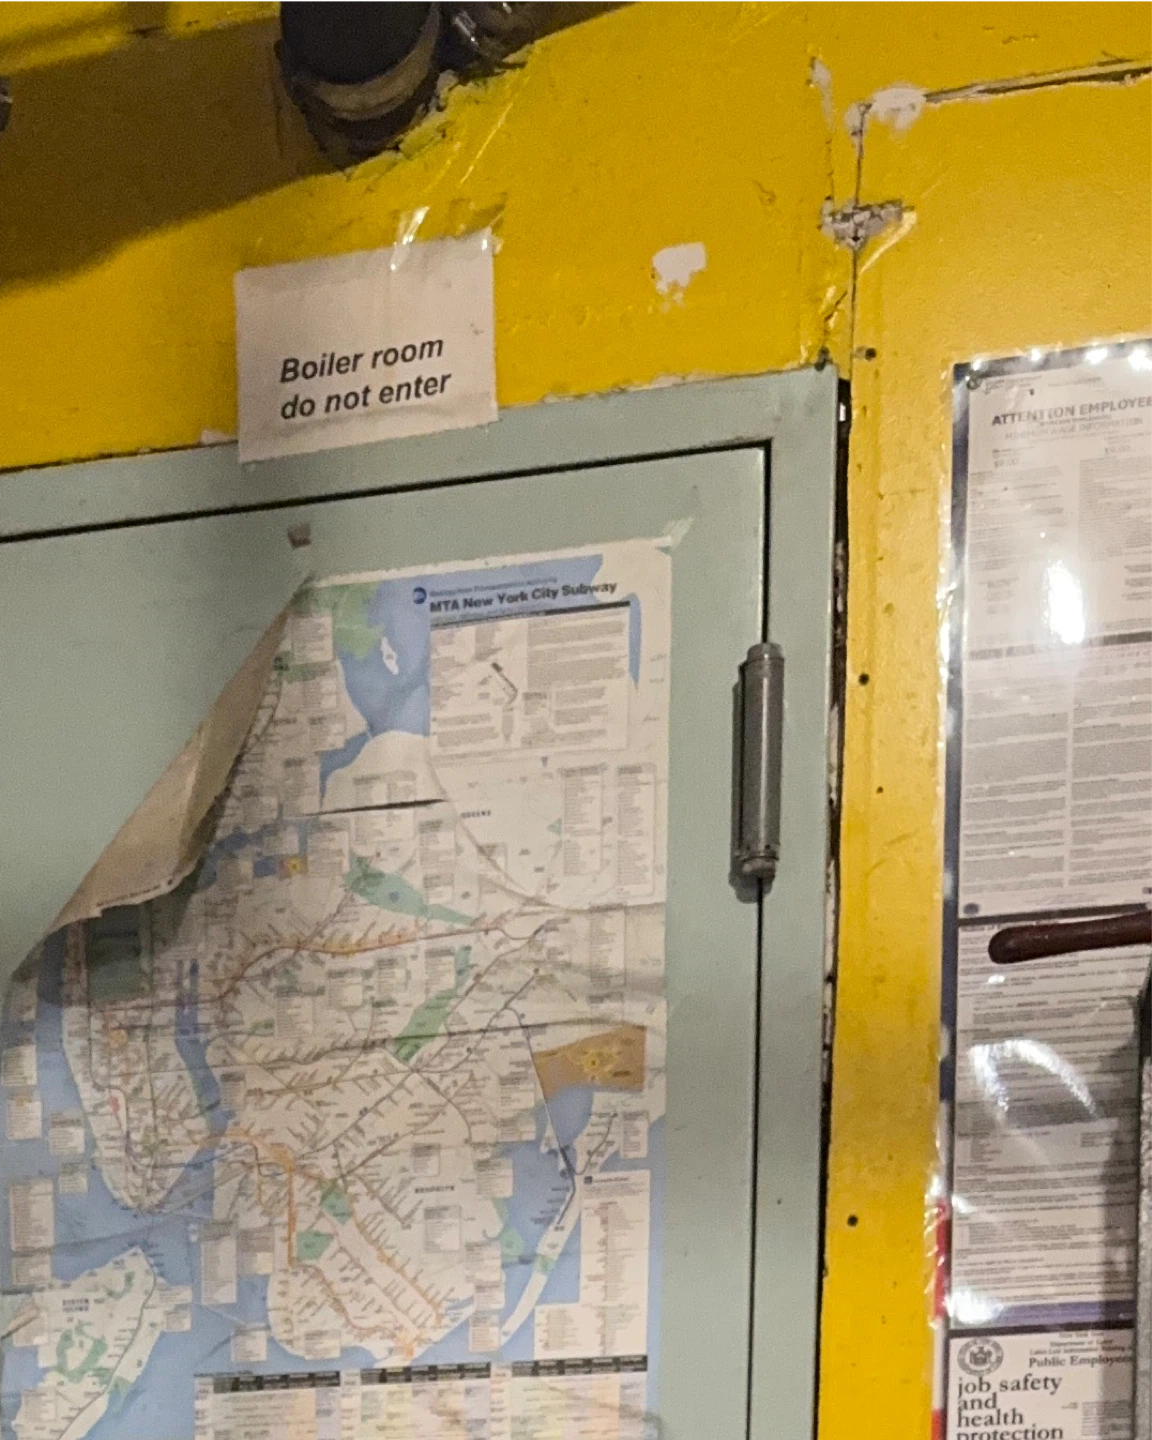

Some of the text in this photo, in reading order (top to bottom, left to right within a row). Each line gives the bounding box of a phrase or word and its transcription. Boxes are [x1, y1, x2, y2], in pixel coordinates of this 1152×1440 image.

[279, 339, 444, 383] Boiler room
[280, 373, 452, 420] do not enter
[991, 405, 1075, 426] ATTENTION
[430, 600, 460, 612] MTA
[462, 597, 494, 609] New
[497, 590, 528, 604] York
[531, 586, 559, 600] City
[561, 581, 618, 598] Subway
[1028, 1356, 1067, 1368] Public
[957, 1372, 1063, 1399] job safety
[957, 1391, 998, 1411] and
[956, 1408, 1024, 1428] health
